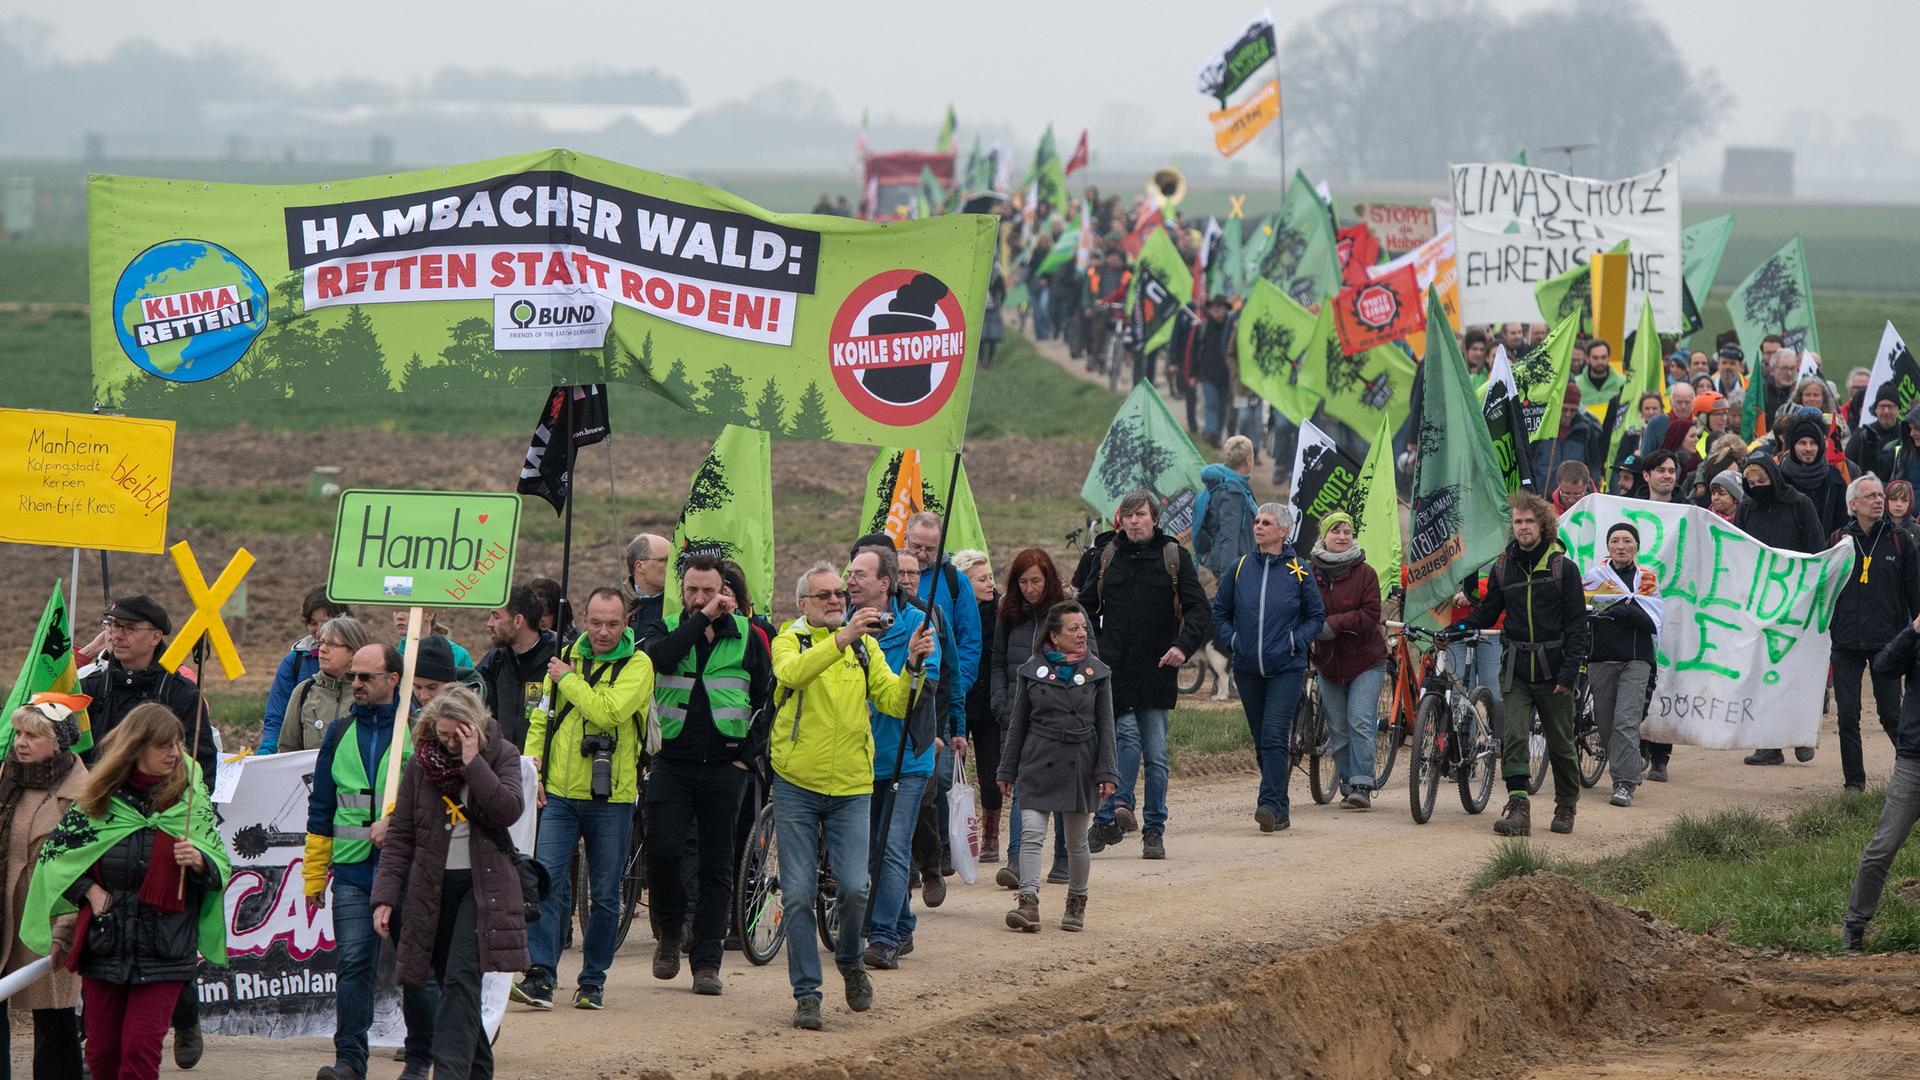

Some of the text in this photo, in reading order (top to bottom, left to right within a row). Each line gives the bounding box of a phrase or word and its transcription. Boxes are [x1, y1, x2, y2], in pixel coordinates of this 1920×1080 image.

[302, 185, 803, 275] HAMBACHER WALD:
[1466, 244, 1664, 294] EHRENSHE
[145, 288, 236, 320] KLIMA
[317, 251, 781, 333] RETTEN STATT RODEN!
[138, 301, 251, 346] RETTEN!
[538, 305, 595, 325] BUND
[573, 328, 597, 336] GERMANY
[833, 331, 963, 366] KOHLE STOPPEN!
[28, 427, 109, 455] Manheim
[27, 457, 101, 476] Kolpingstadt
[43, 475, 85, 490] Kerpen
[110, 453, 168, 517] bleibt!
[87, 497, 116, 515] Kreis
[357, 505, 485, 571] Hambi
[445, 541, 509, 601] bleibt!
[1621, 508, 1854, 634] BLEIBEN
[197, 969, 337, 1003] im Rheinlan
